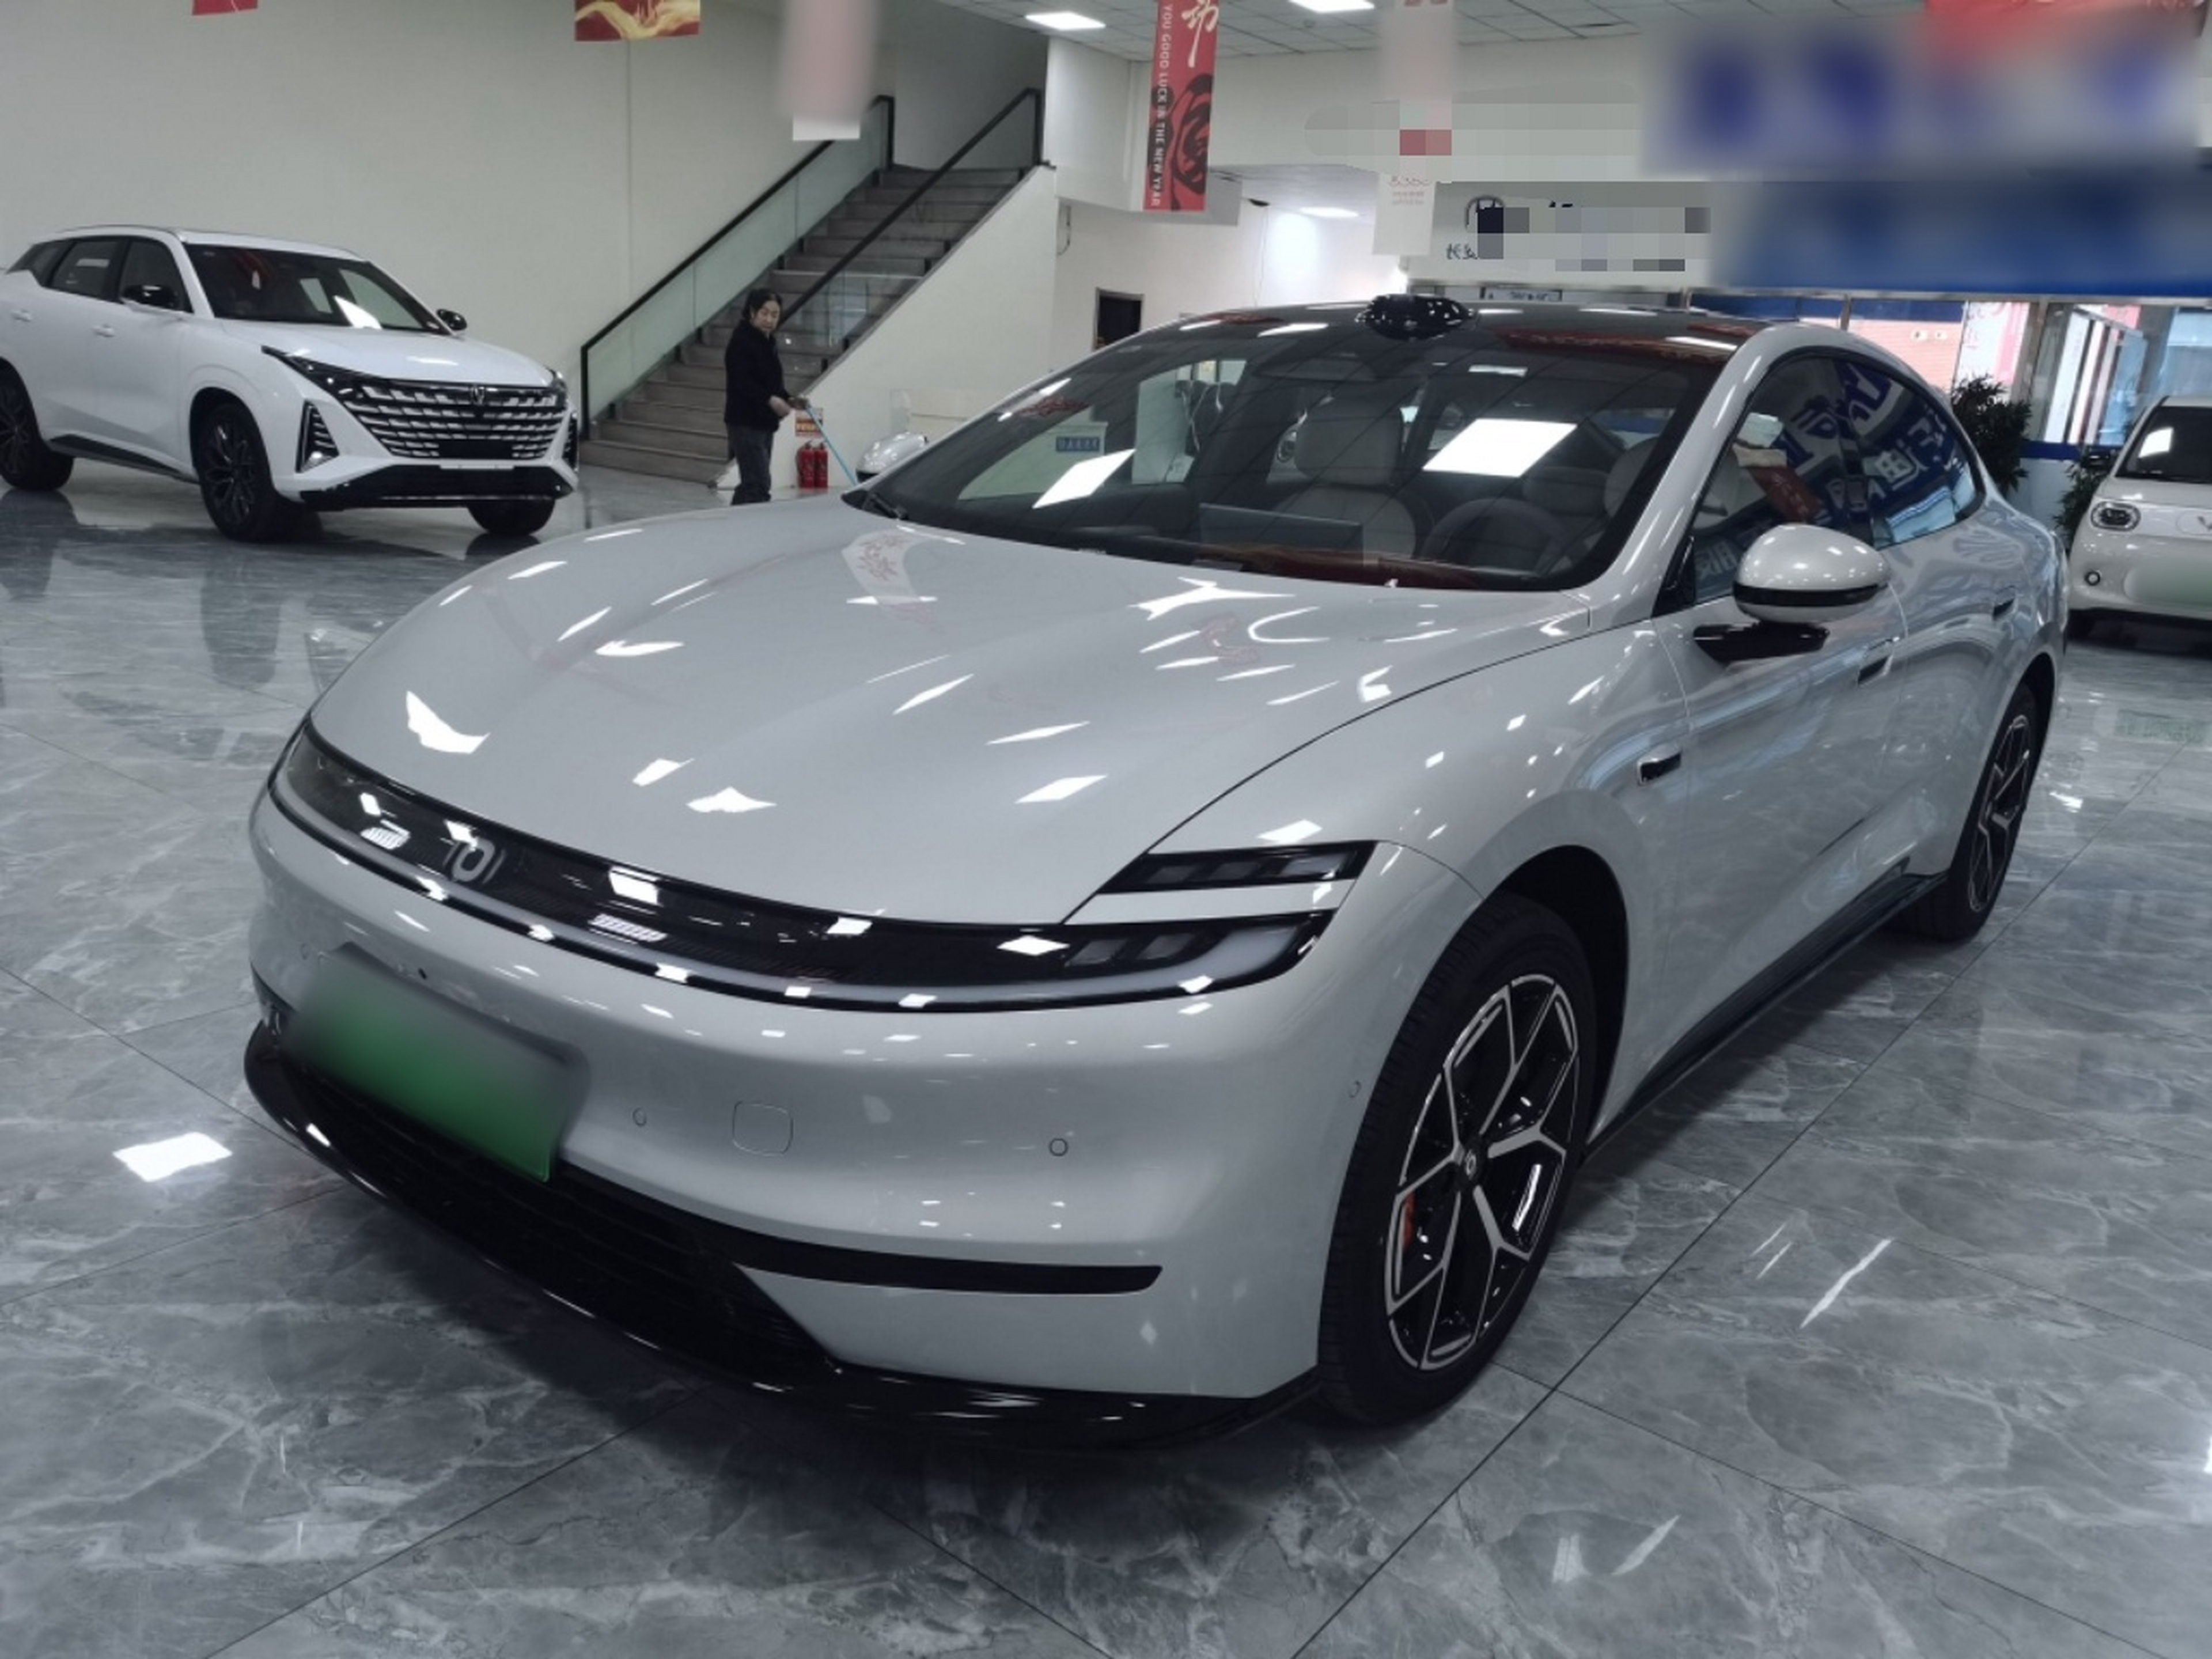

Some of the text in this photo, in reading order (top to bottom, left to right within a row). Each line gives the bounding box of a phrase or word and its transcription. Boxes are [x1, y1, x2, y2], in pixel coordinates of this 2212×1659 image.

[1162, 5, 1173, 29] YOU
[1160, 34, 1172, 69] GOOD
[1157, 73, 1169, 103] LUCK
[1156, 123, 1166, 143] THE
[1153, 146, 1164, 175] NEW
